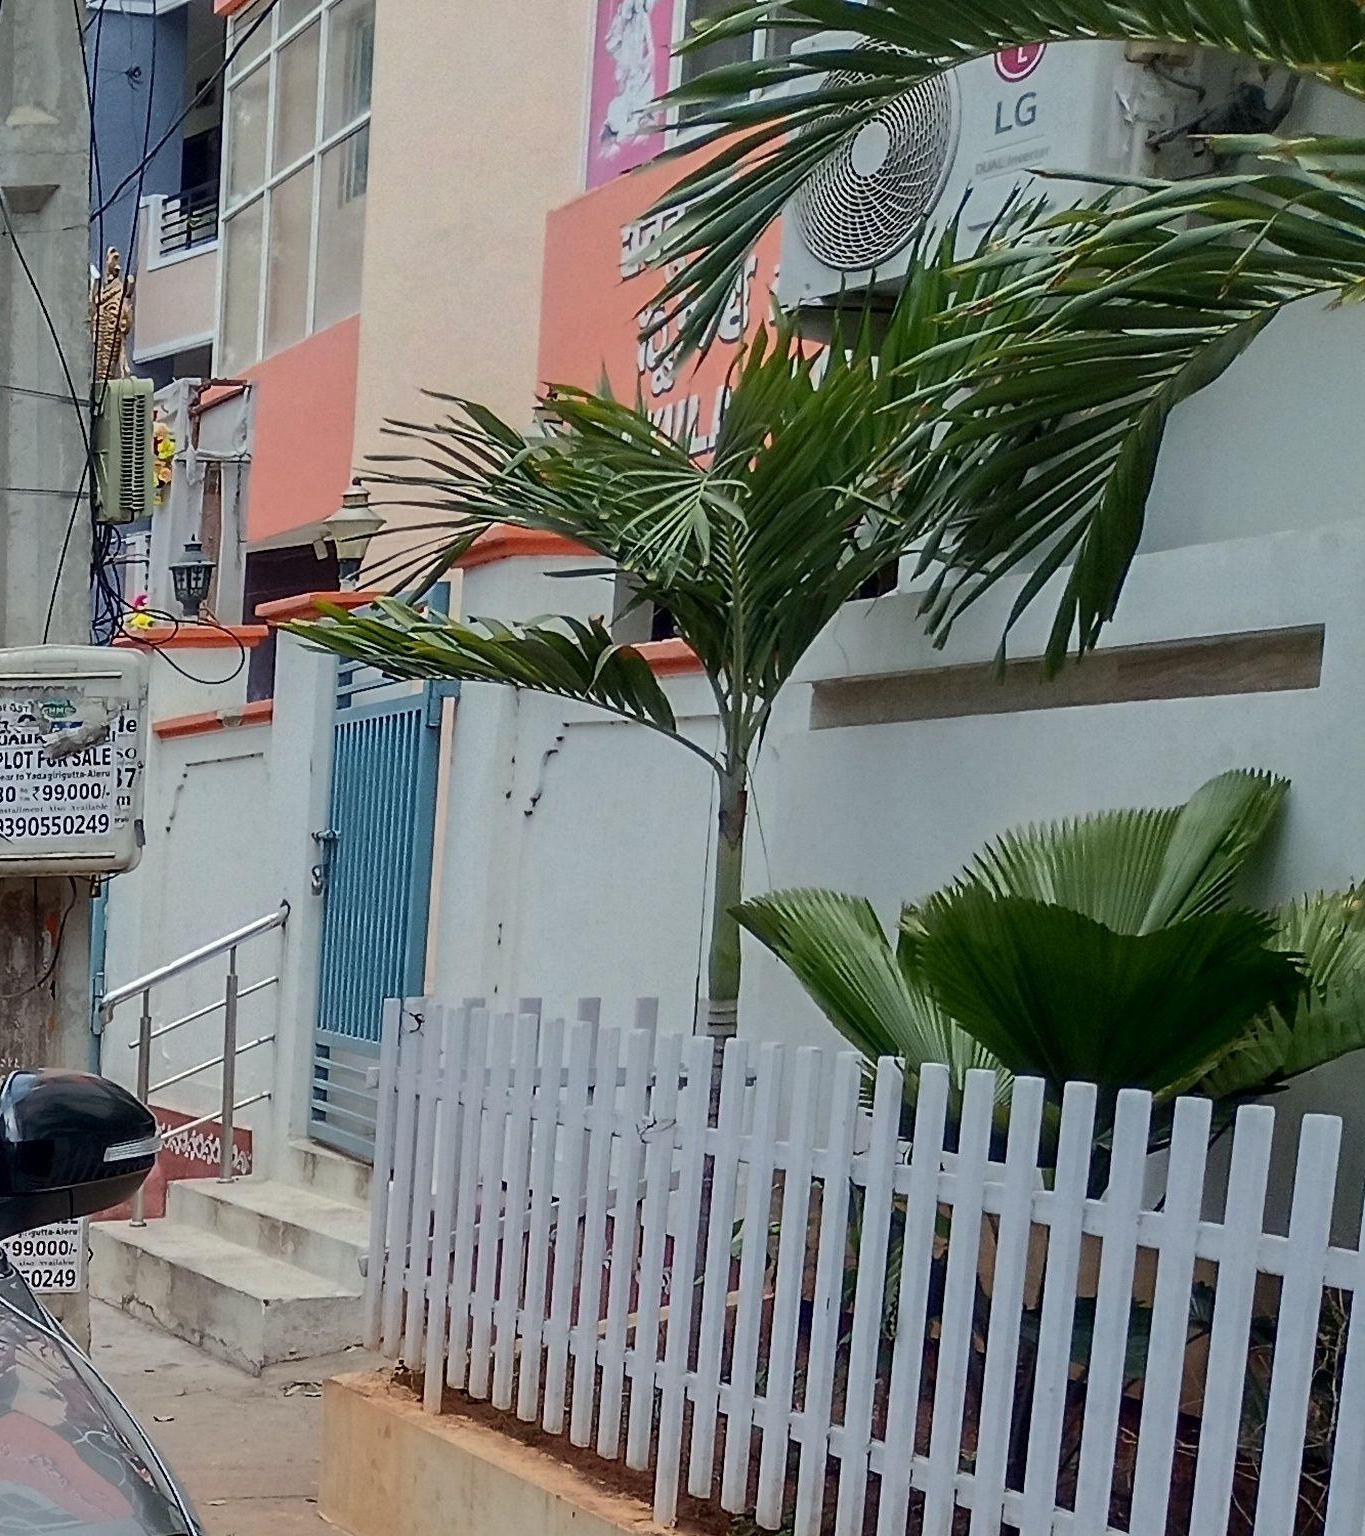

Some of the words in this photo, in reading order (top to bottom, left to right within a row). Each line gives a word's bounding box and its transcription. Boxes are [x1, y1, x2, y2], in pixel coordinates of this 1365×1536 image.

[994, 92, 1038, 135] LG
[975, 157, 1005, 176] DUAL
[71, 747, 111, 766] SALE
